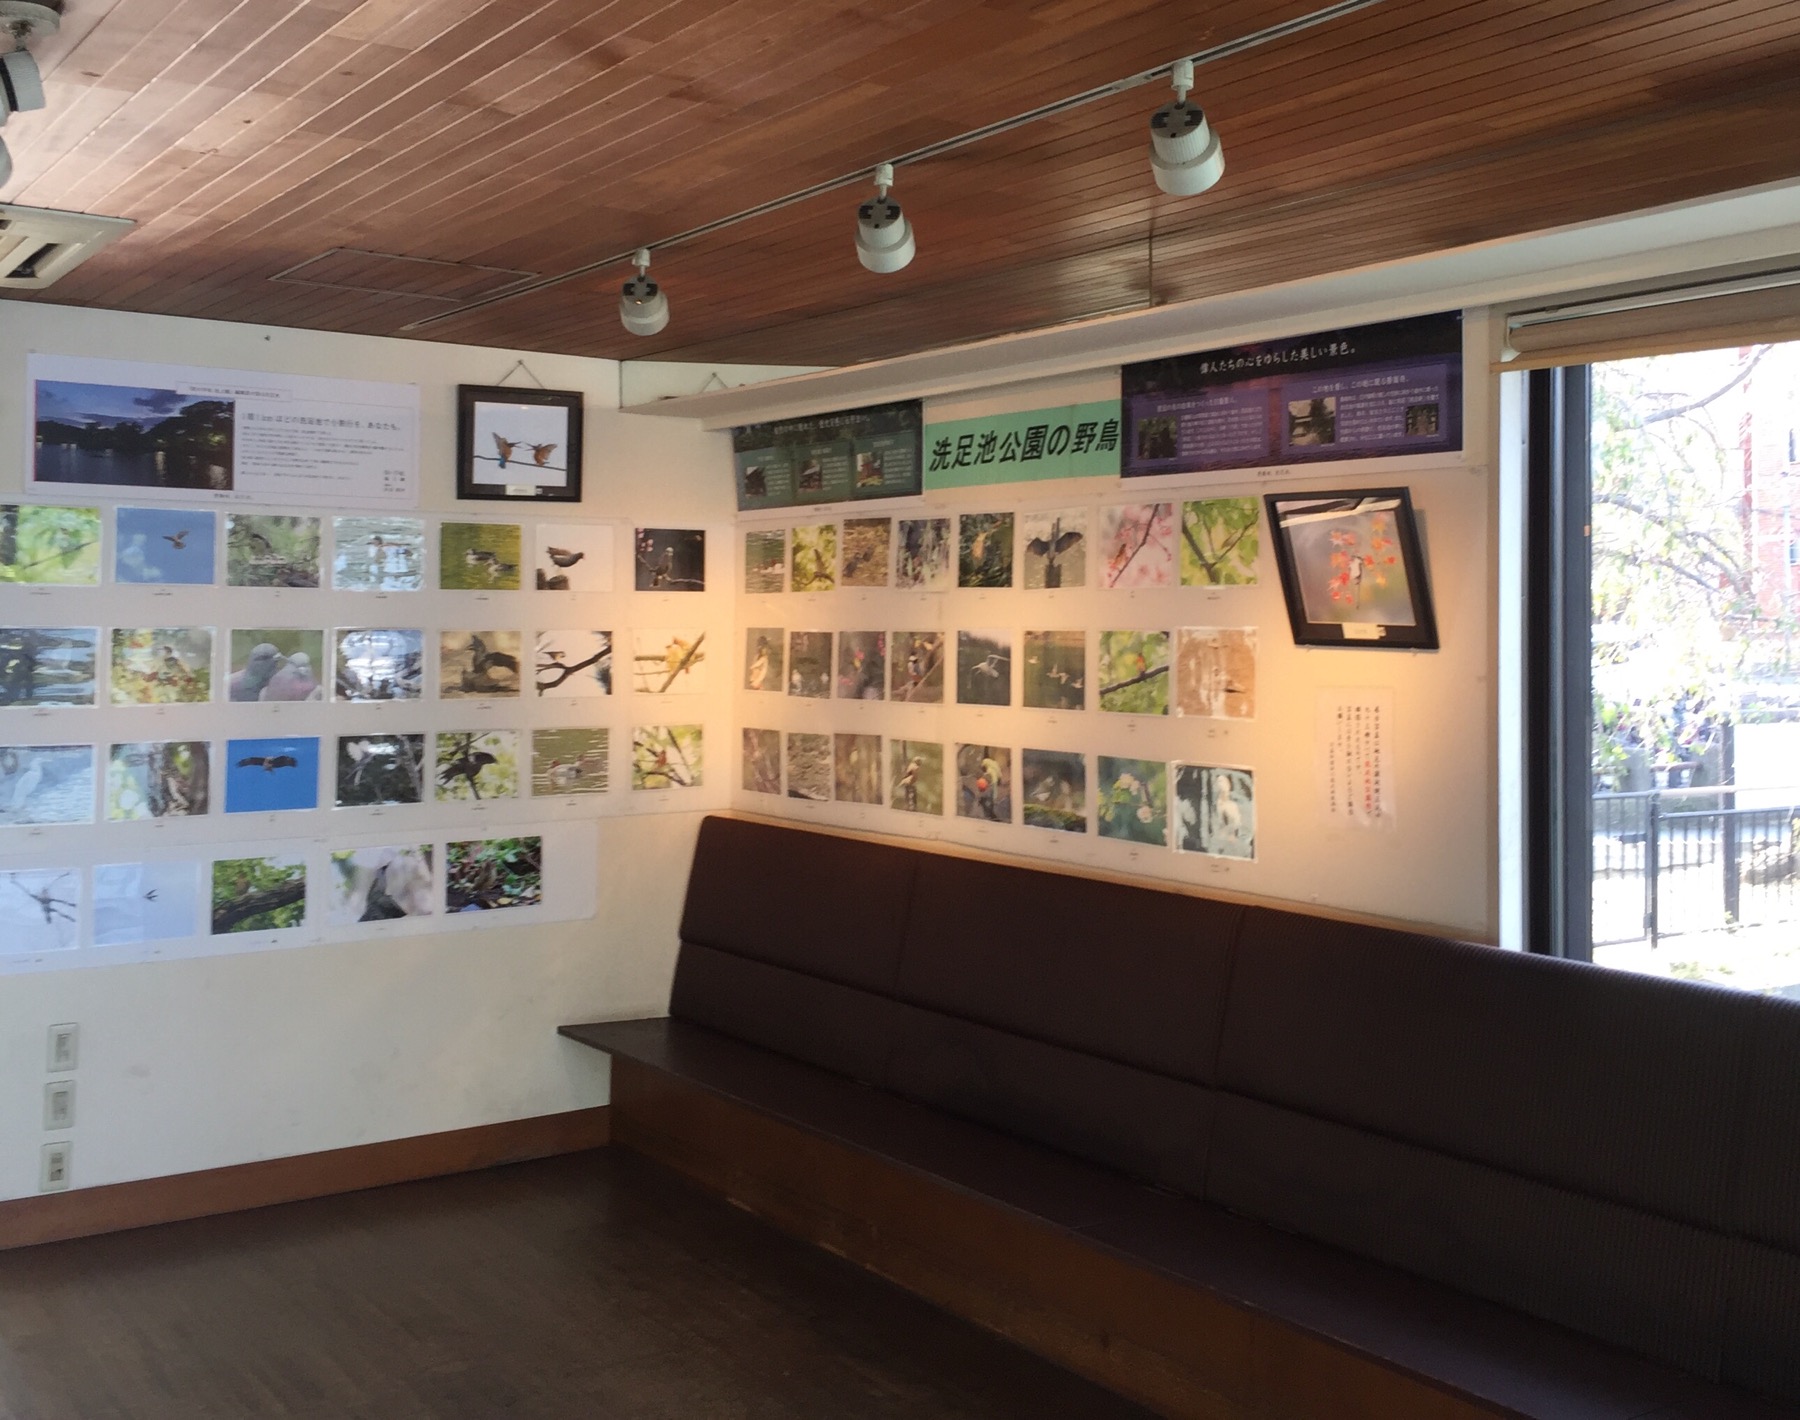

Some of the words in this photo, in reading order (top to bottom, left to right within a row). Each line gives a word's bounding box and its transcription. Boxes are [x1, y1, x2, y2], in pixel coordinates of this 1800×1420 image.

[928, 418, 1120, 472] 洗足池公園の野鳥
